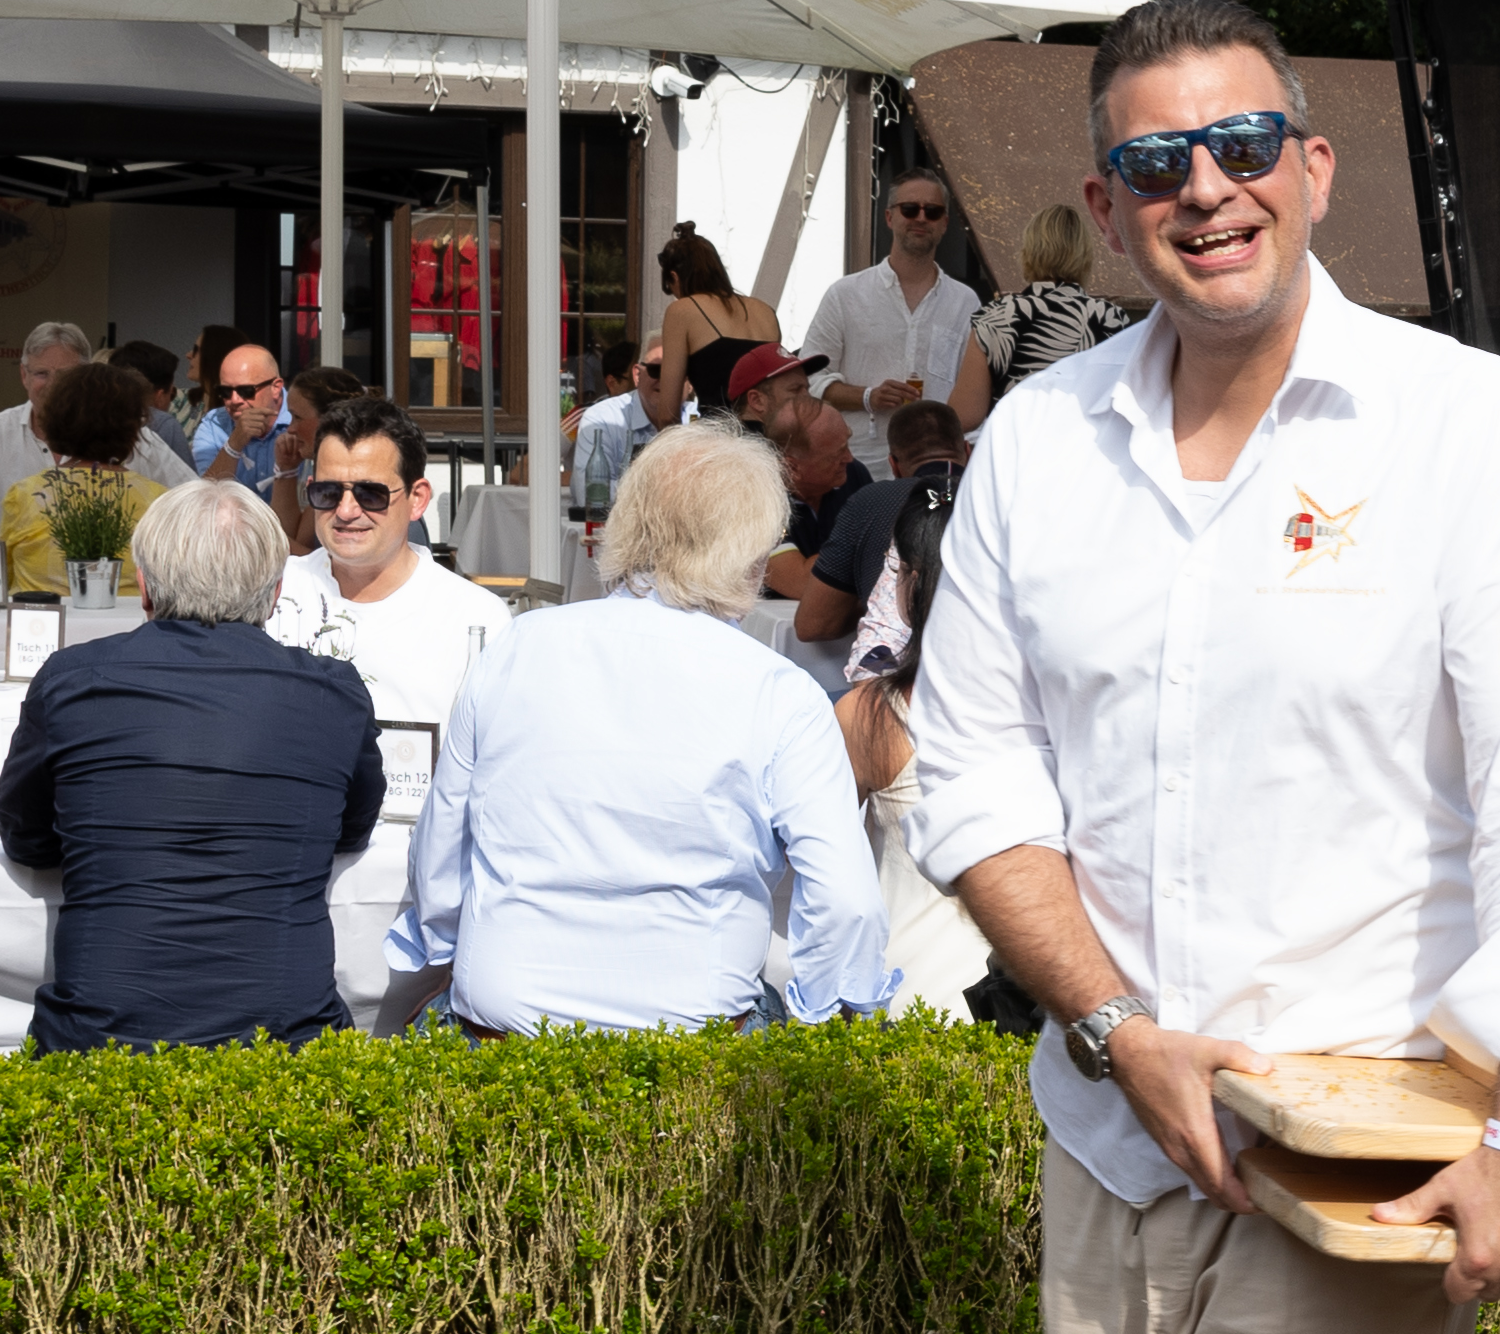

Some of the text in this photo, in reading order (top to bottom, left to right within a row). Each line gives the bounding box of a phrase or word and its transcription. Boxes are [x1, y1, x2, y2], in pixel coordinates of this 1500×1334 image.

[17, 642, 55, 652] Tisch 11
[18, 655, 34, 664] (BG
[390, 772, 429, 784] sch 12
[406, 787, 426, 800] 122)
